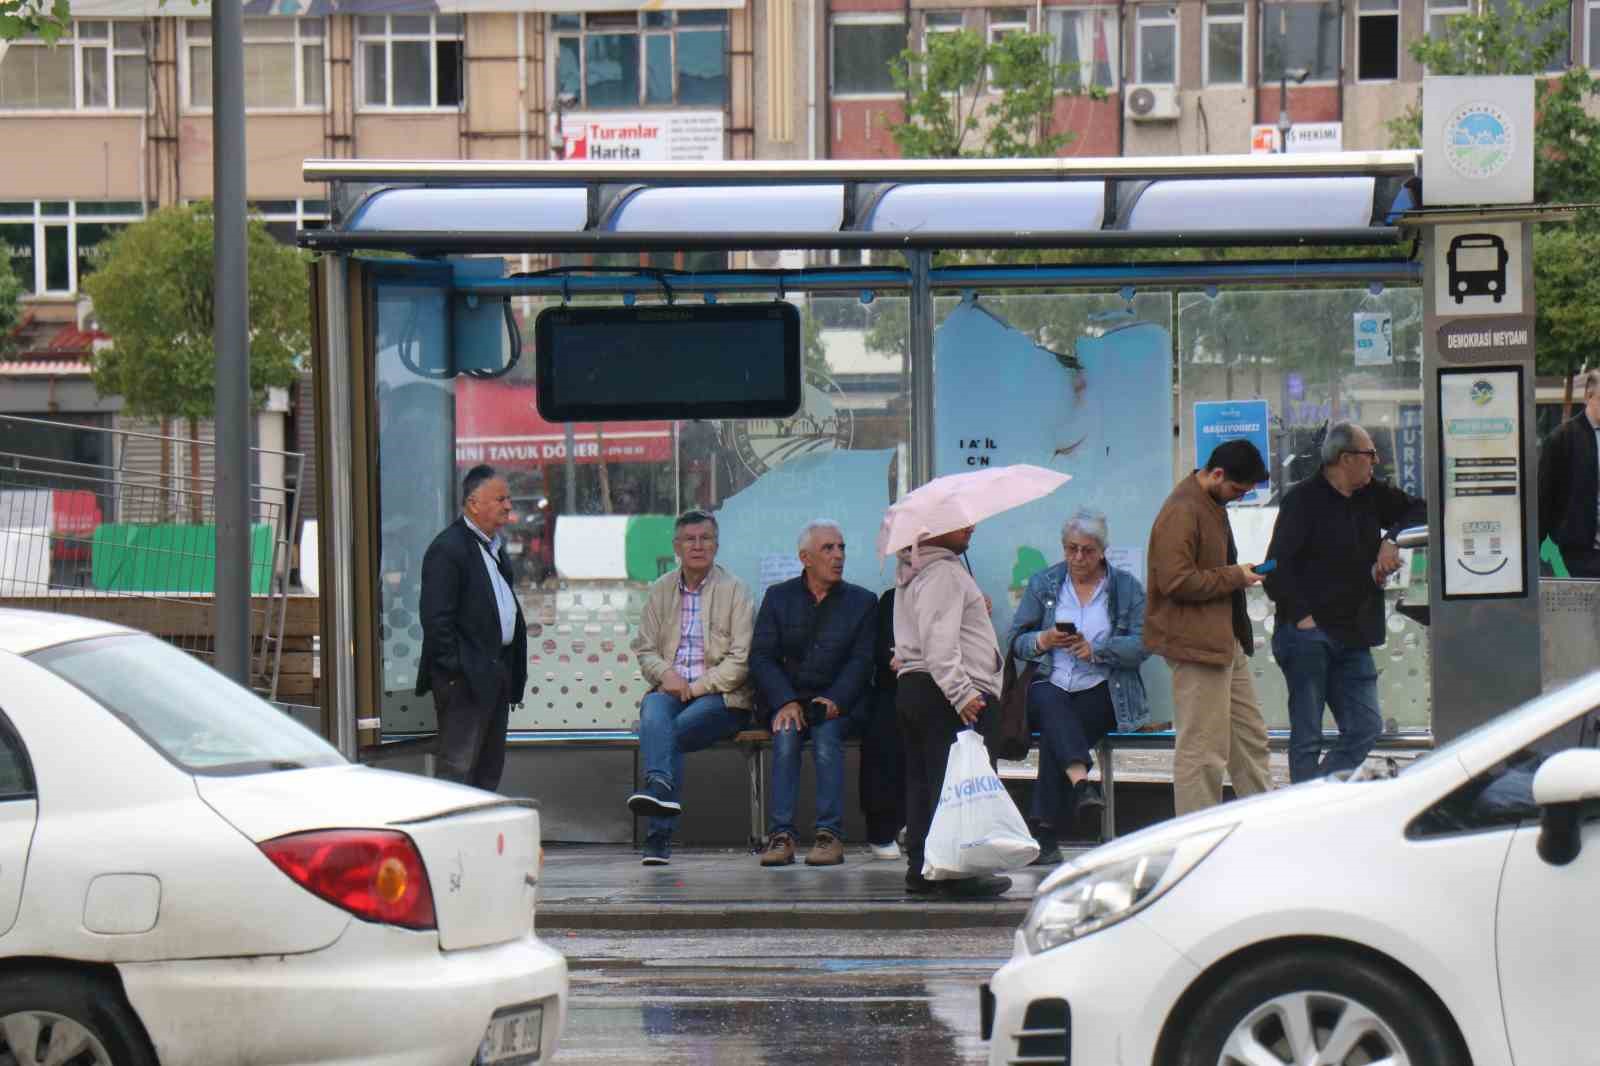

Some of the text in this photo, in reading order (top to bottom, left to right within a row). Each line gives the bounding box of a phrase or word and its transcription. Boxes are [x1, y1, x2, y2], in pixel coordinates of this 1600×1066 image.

[591, 125, 658, 139] Turanlar
[591, 145, 640, 159] Harita
[1448, 329, 1528, 349] DEMOKRASİ MEYDANI
[490, 445, 538, 460] TAVUK
[1403, 411, 1417, 497] TURKC
